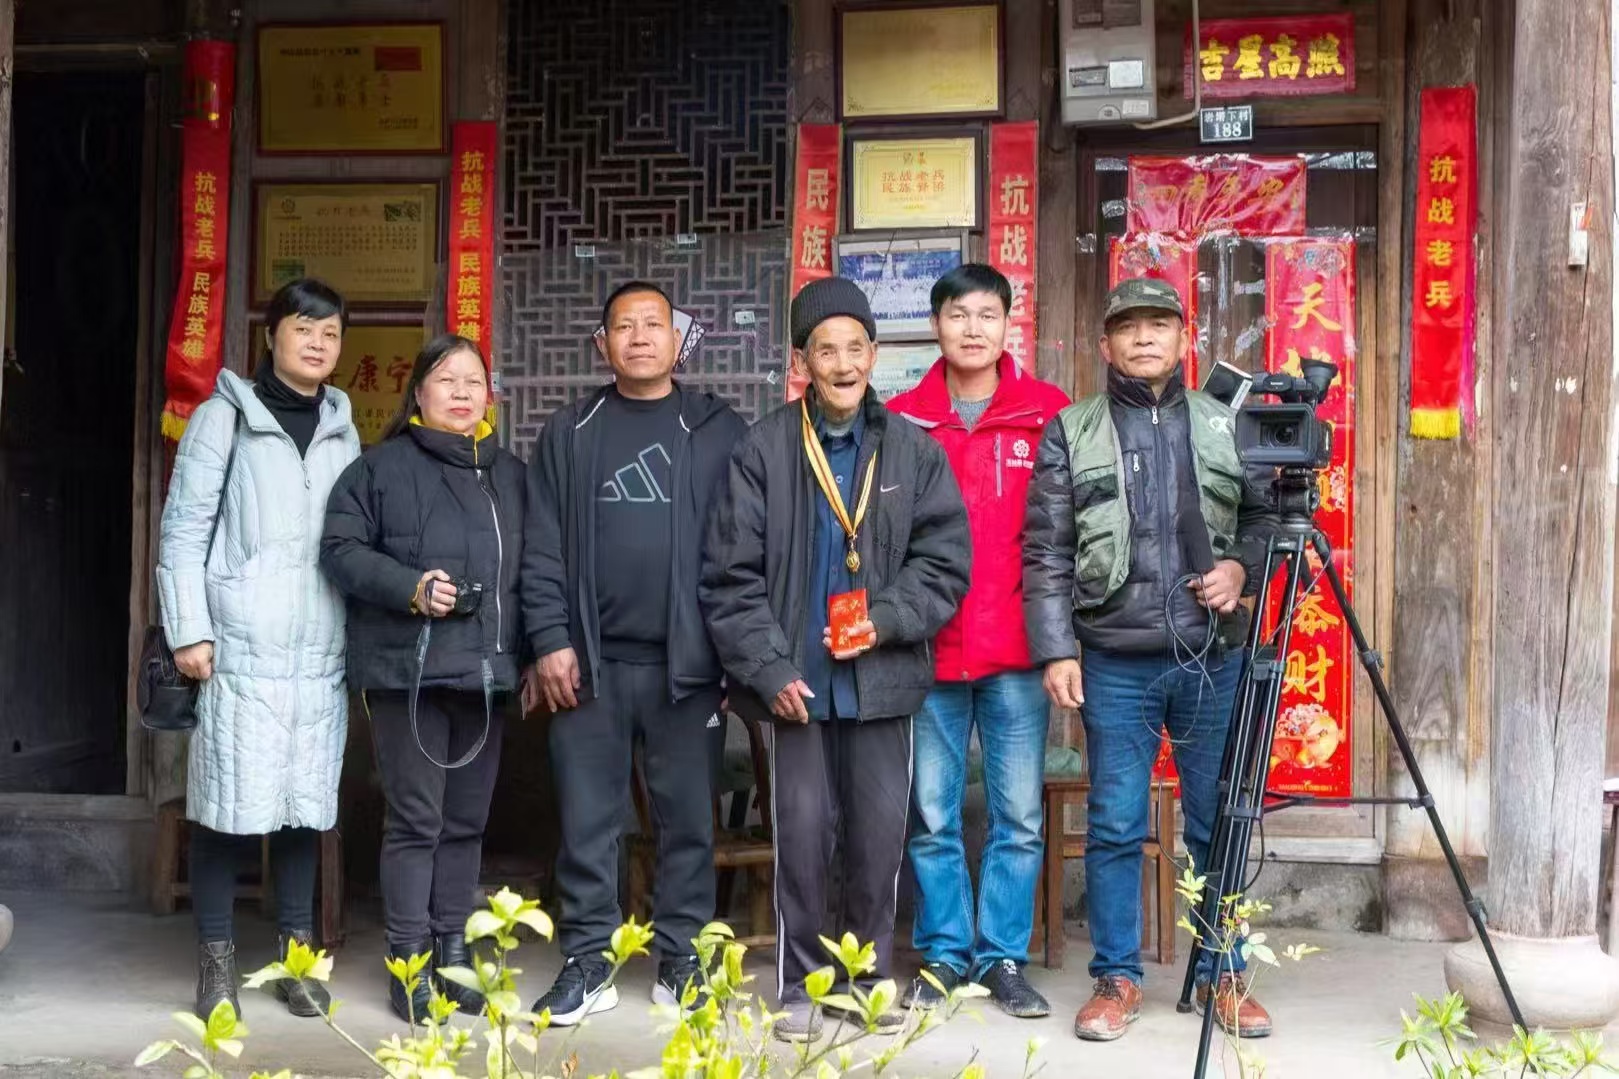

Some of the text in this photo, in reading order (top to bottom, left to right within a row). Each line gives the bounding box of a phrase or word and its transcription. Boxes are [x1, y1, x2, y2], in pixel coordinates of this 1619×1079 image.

[1199, 35, 1344, 80] 吉星高照
[1213, 122, 1242, 138] 188
[183, 171, 216, 359] 抗战老兵 民族英雄
[458, 150, 483, 342] 抗战老兵 民族英雄
[801, 168, 830, 294] 民族
[1426, 158, 1458, 310] 抗战老兵
